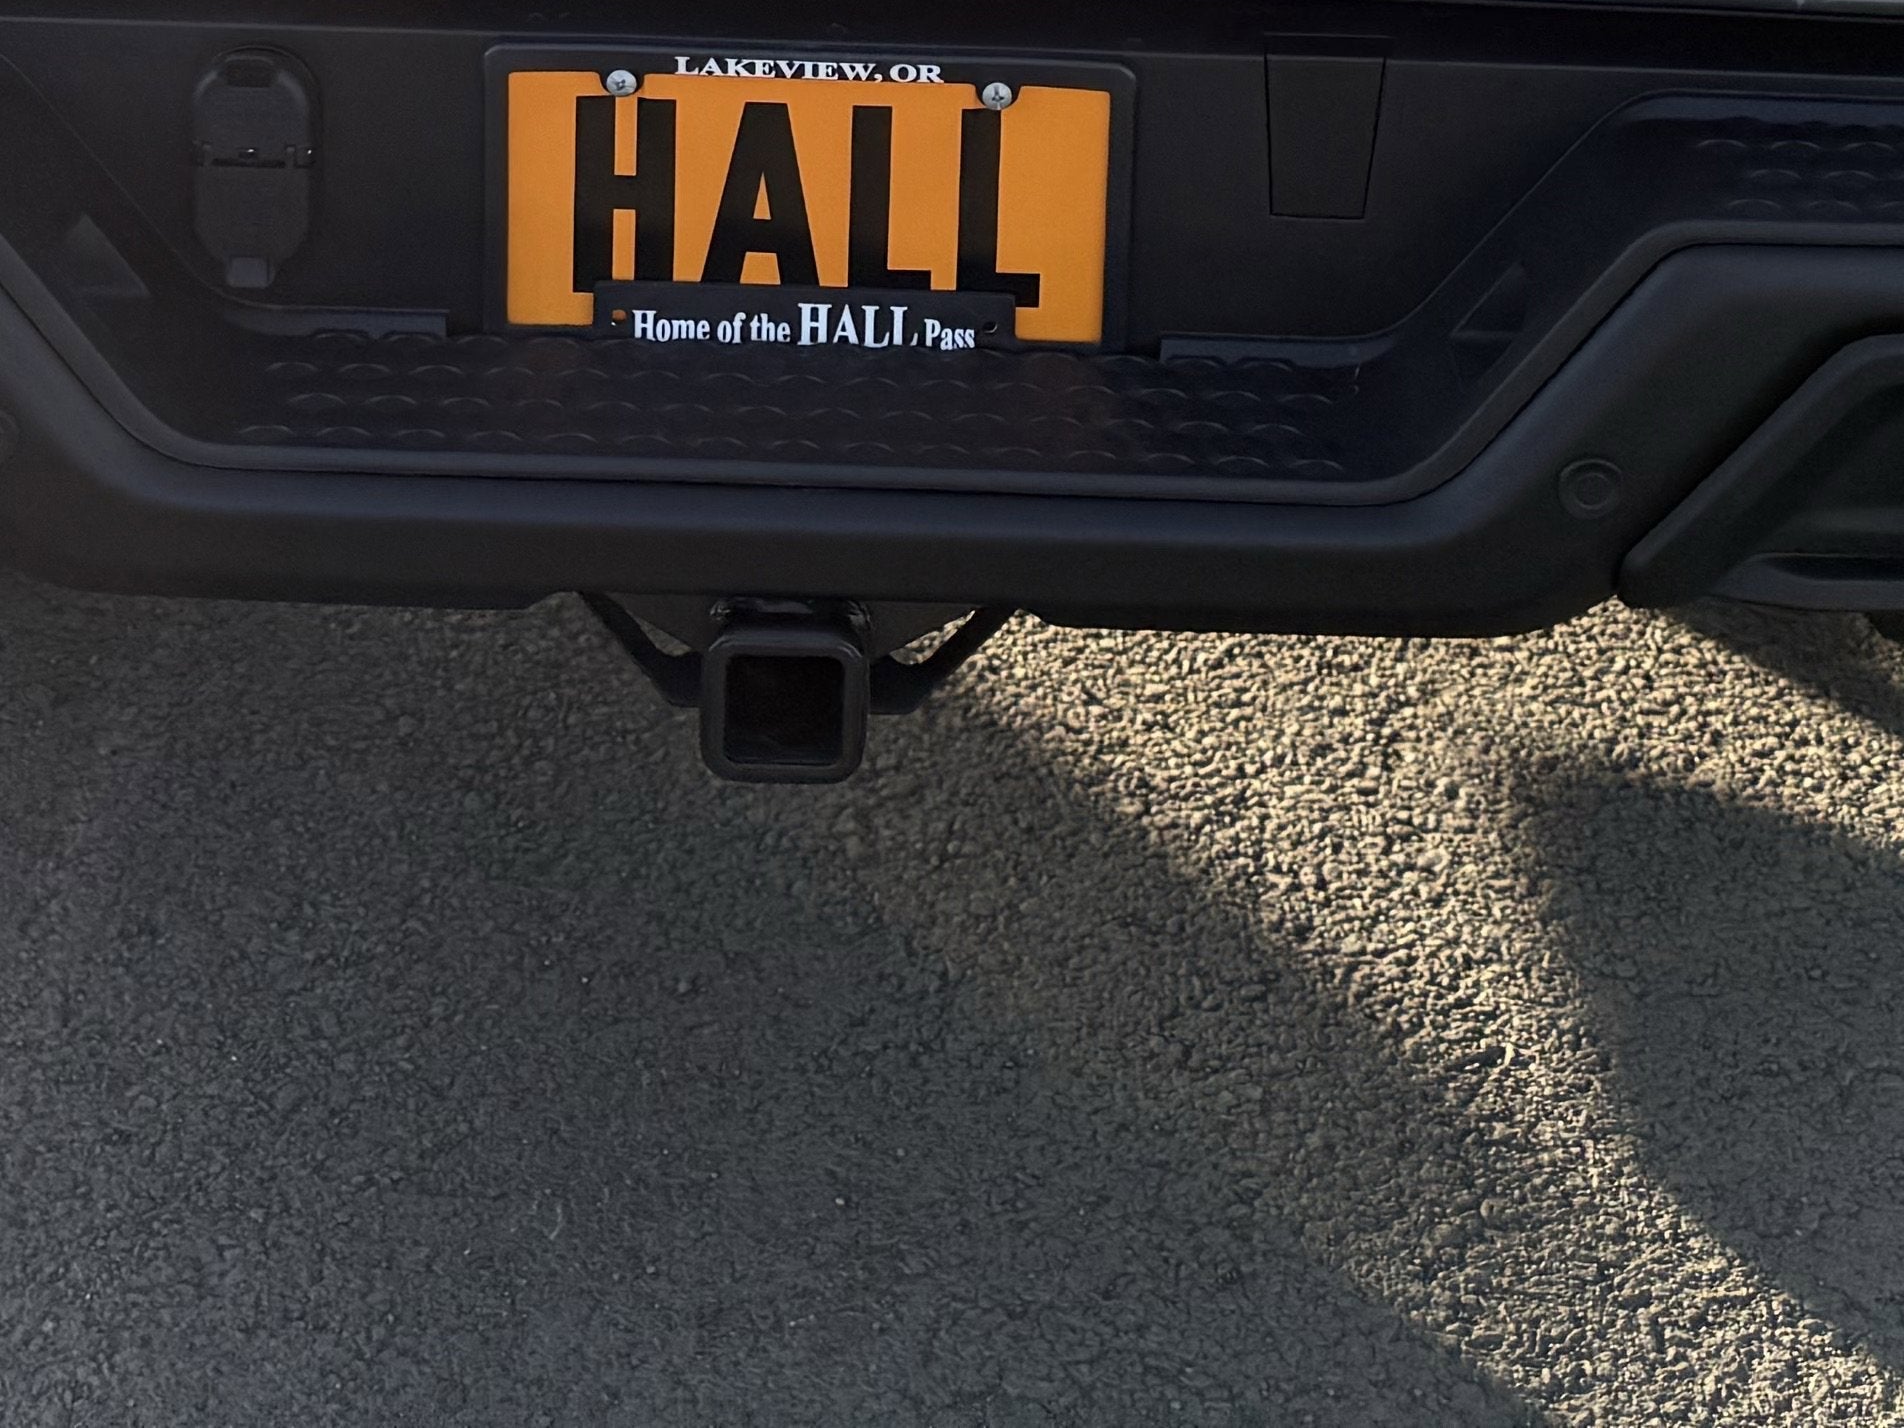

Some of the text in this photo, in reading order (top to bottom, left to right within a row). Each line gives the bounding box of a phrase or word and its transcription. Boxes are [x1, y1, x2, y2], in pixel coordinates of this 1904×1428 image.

[674, 56, 945, 84] LAKEVIEW, OR
[572, 95, 1041, 308] HALL
[632, 303, 976, 351] Home of the HALL Pass
